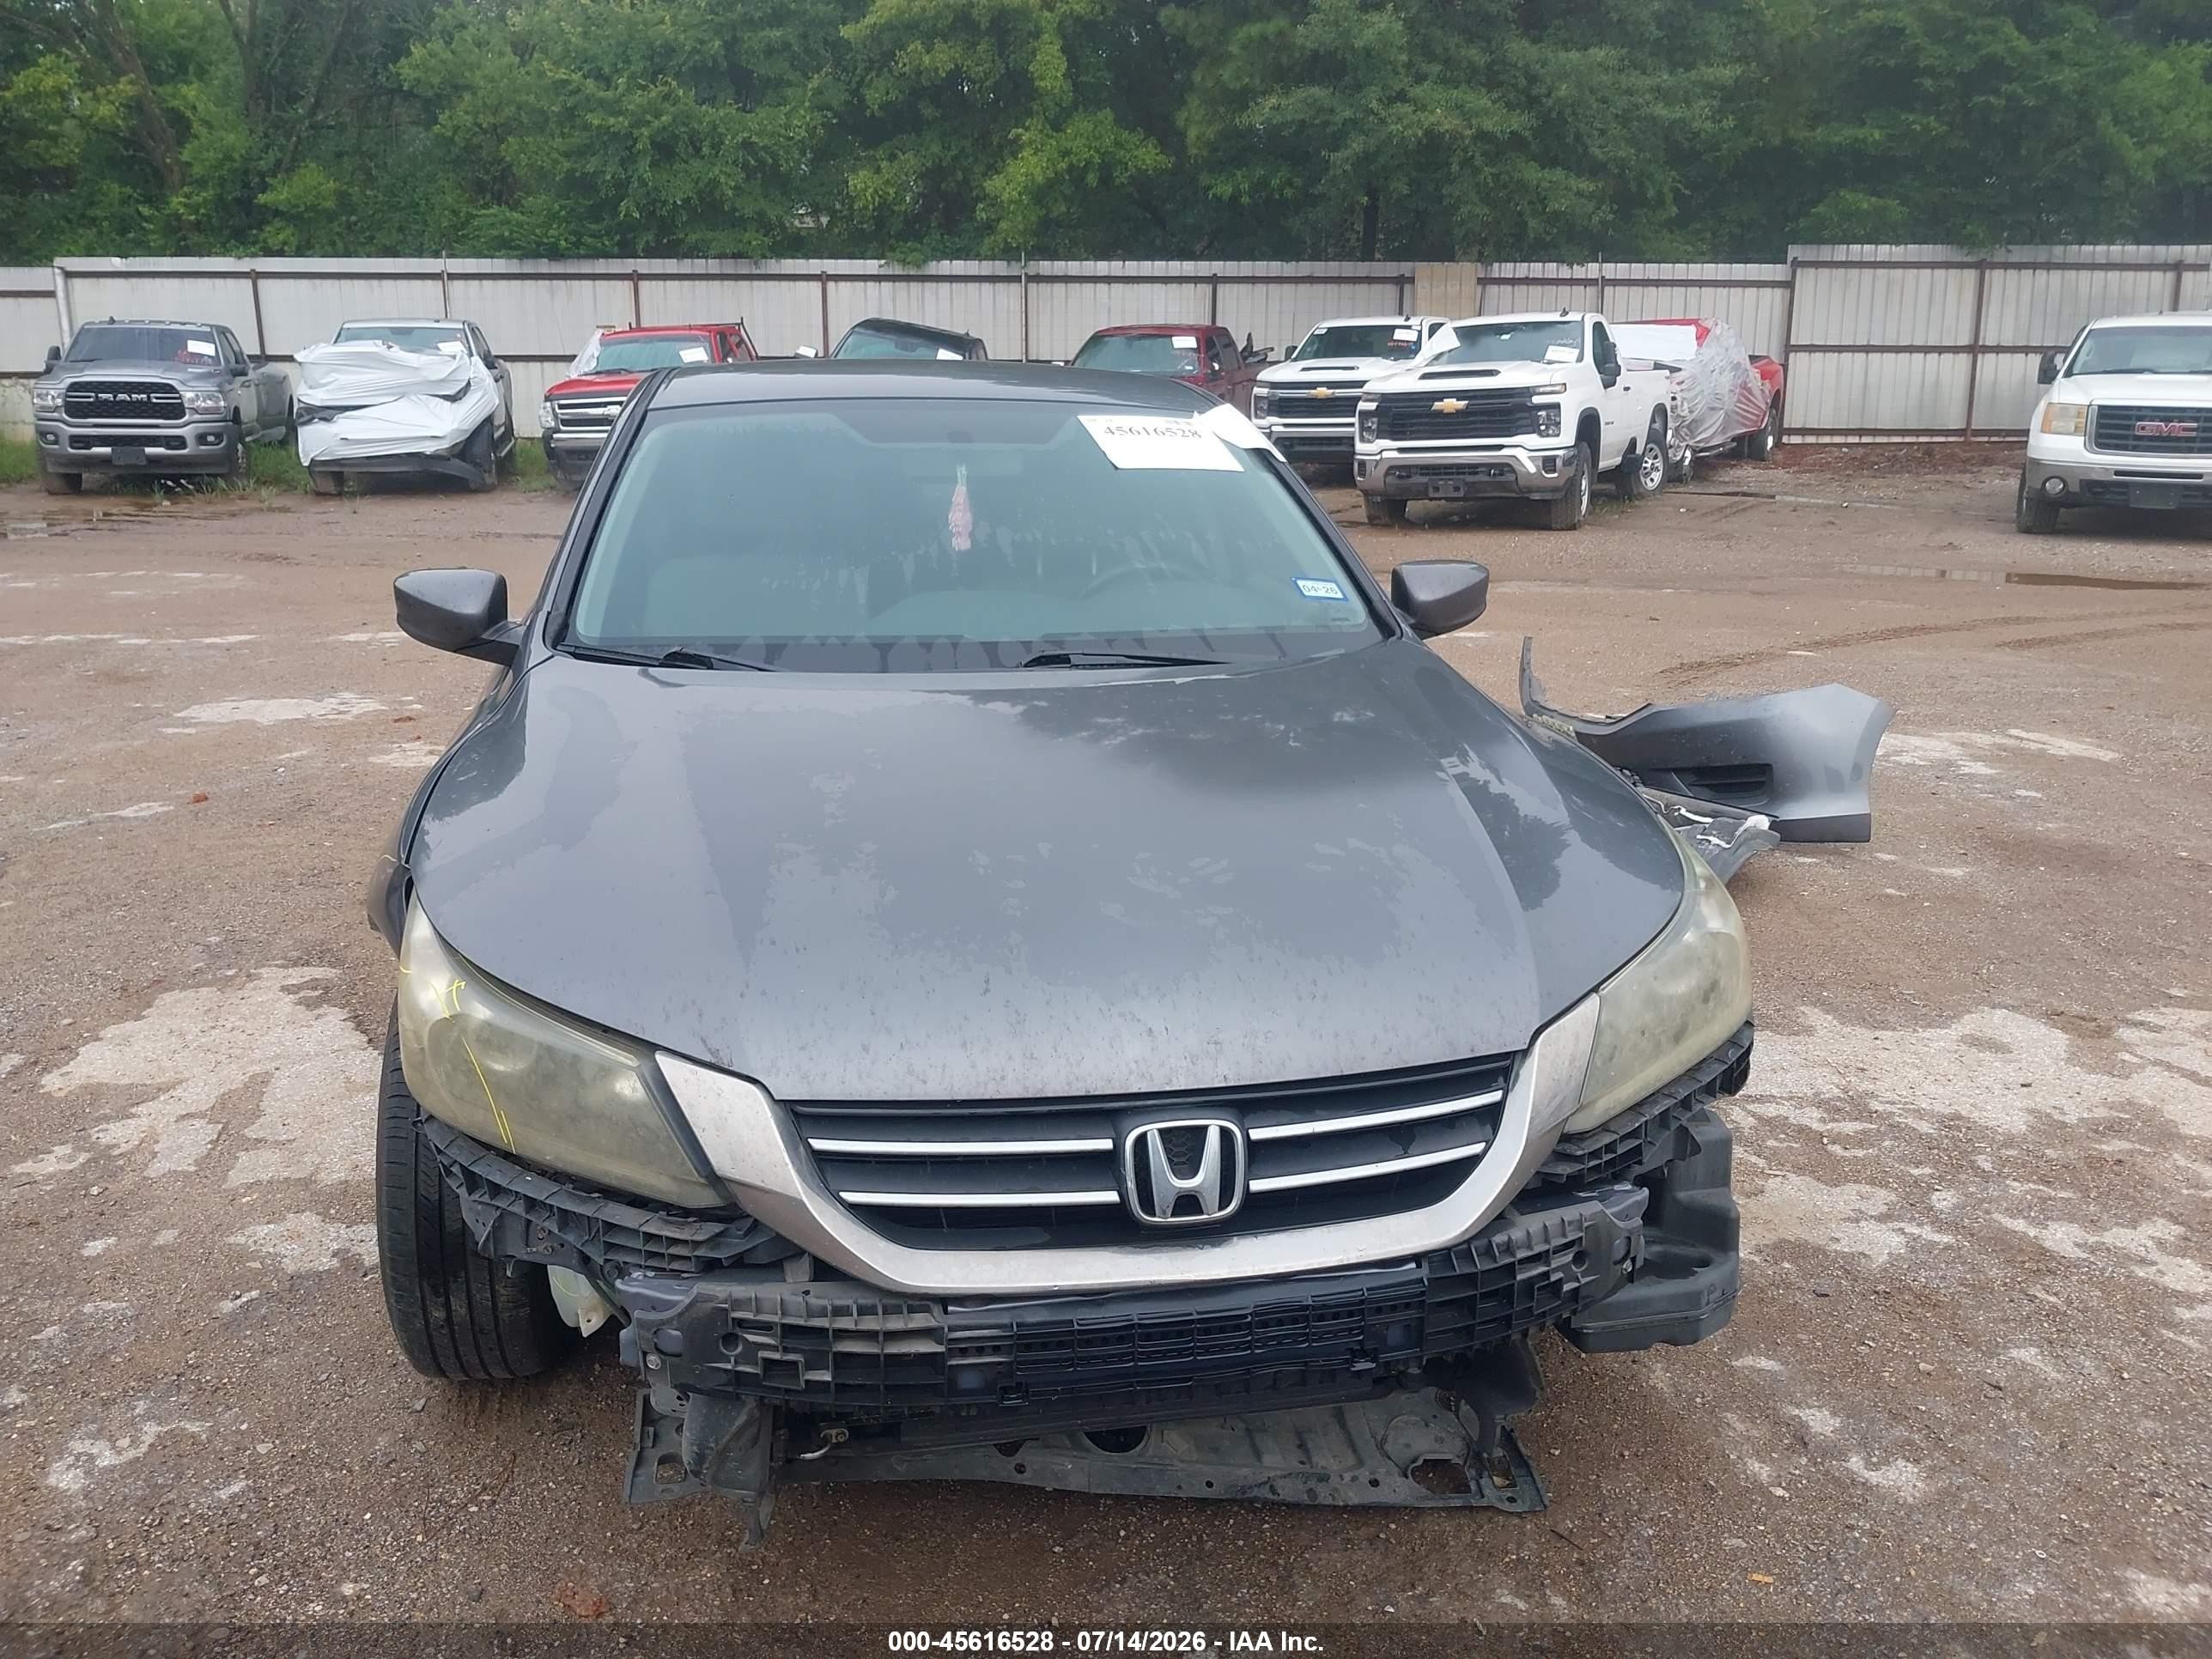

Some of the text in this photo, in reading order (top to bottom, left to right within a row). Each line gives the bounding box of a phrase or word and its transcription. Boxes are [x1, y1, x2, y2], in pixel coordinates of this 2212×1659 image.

[98, 393, 148, 402] RAM
[1103, 426, 1202, 439] 45616528
[2135, 422, 2198, 436] GMC
